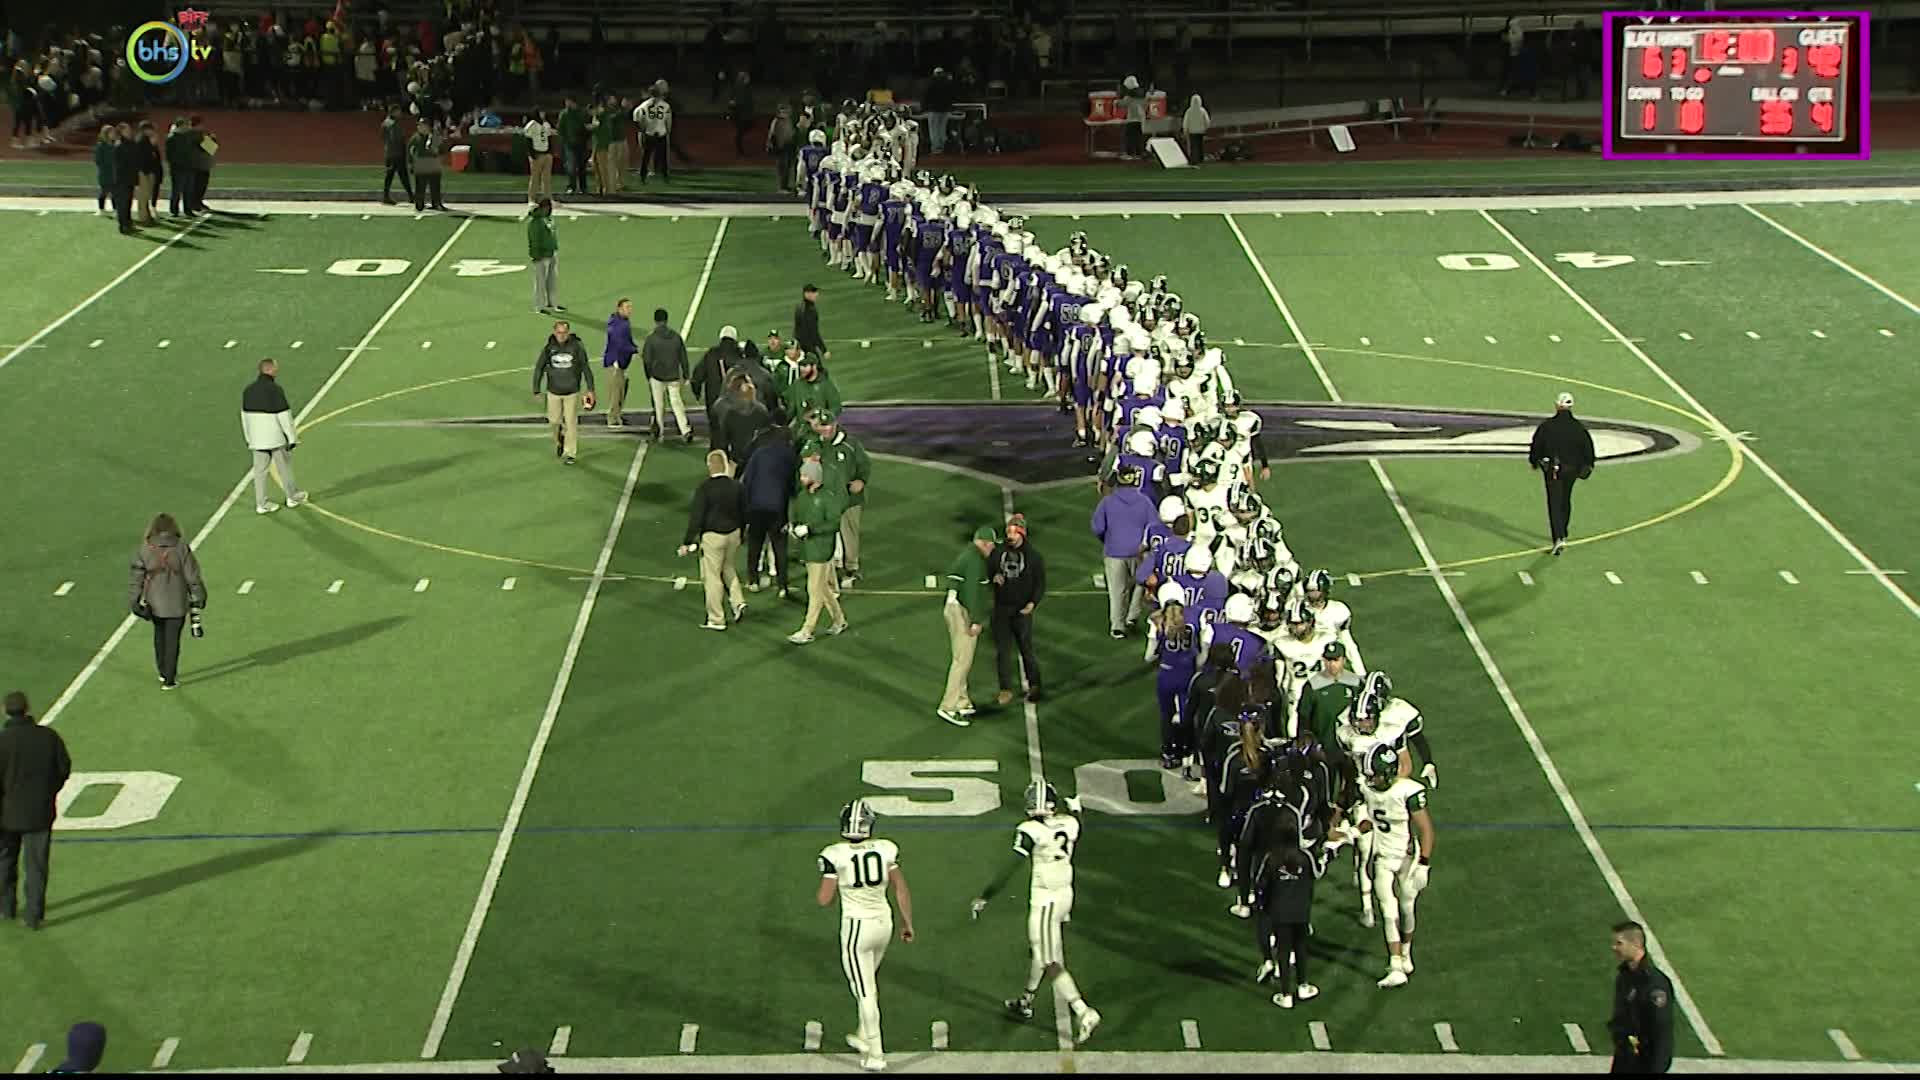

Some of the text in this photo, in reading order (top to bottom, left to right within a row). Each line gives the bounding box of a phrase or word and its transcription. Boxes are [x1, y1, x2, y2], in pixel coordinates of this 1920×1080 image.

[1292, 660, 1322, 680] 24
[1373, 809, 1391, 834] 5
[850, 851, 883, 888] 10
